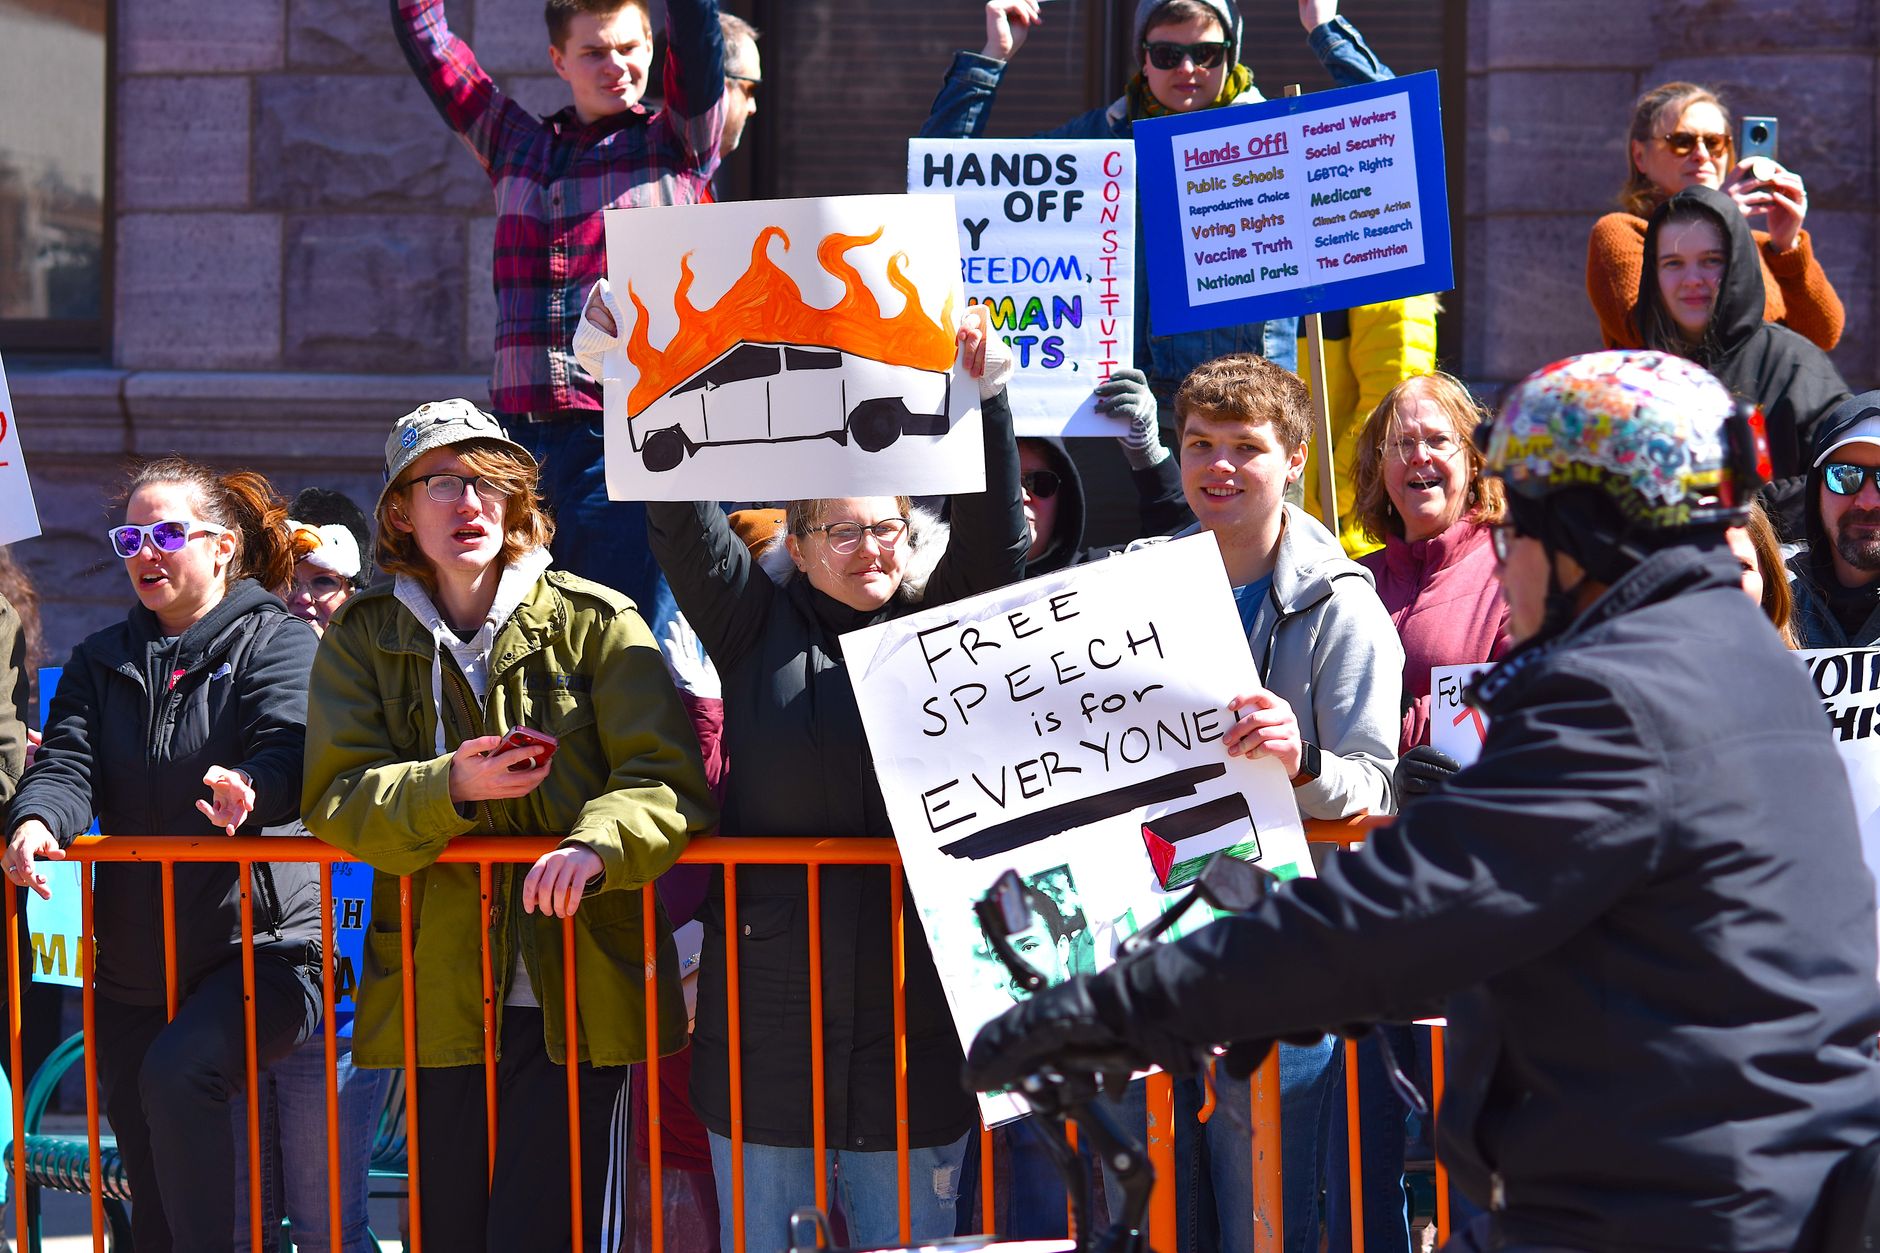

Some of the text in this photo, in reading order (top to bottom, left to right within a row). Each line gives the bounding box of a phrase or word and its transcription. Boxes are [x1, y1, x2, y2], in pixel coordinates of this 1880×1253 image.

[1302, 110, 1396, 138] Federal Workers
[1184, 131, 1288, 167] Hands Off!
[1305, 133, 1395, 160] Social Security
[923, 153, 1078, 187] HANDS
[1186, 166, 1285, 195] Public Schools
[1307, 157, 1393, 183] LGBTQ+ Rights
[1003, 190, 1084, 223] OFF
[1189, 191, 1290, 216] Reproductive Choice
[1310, 186, 1372, 207] Medicare
[1191, 213, 1285, 240] Voting Rights
[1312, 200, 1411, 227] Climate Change Action
[1363, 218, 1413, 239] Research
[963, 218, 990, 251] Y
[1194, 236, 1293, 266] Vaccine Truth
[1316, 244, 1408, 269] The Constitution
[961, 255, 1092, 284] EEDOM,
[1097, 151, 1122, 386] CONSTITUTI
[1197, 262, 1299, 292] National Parks
[968, 295, 1083, 331] MAN
[916, 591, 1080, 683] FREE
[922, 621, 1165, 737] SPEECH
[1805, 651, 1880, 700] OT
[1030, 684, 1164, 737] is for
